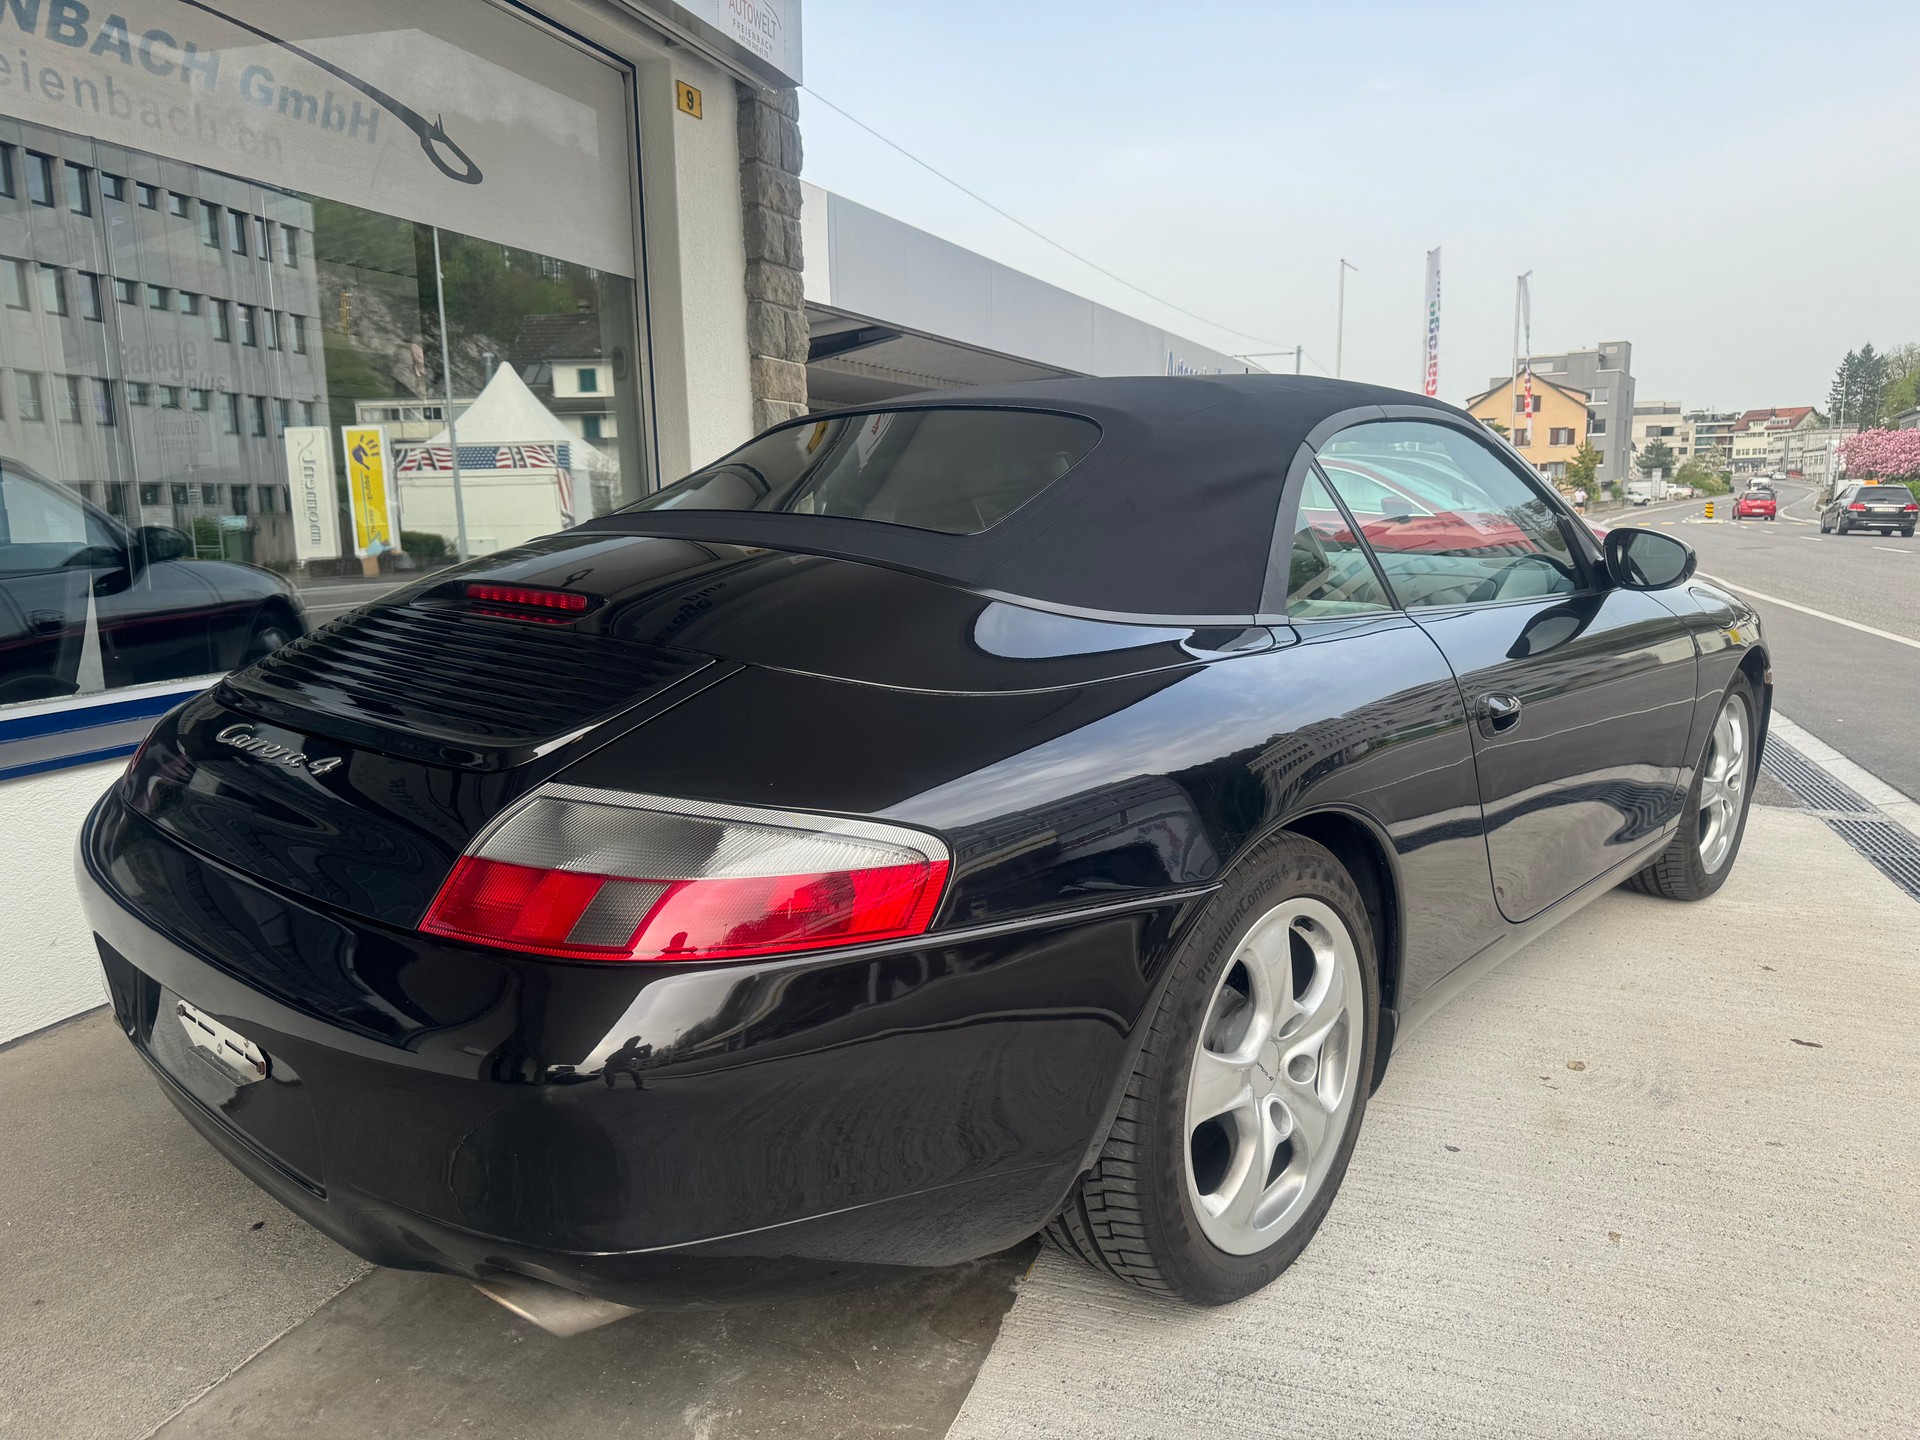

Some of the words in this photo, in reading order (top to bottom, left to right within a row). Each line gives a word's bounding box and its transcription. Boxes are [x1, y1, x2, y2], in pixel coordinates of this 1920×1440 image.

[728, 0, 777, 41] AUTOWELT
[732, 18, 773, 52] FREIENBACH
[239, 64, 381, 145] GmbH
[686, 90, 695, 110] 9
[215, 723, 309, 768] Carrera
[308, 756, 344, 776] 4
[1195, 871, 1283, 986] PremiumContact
